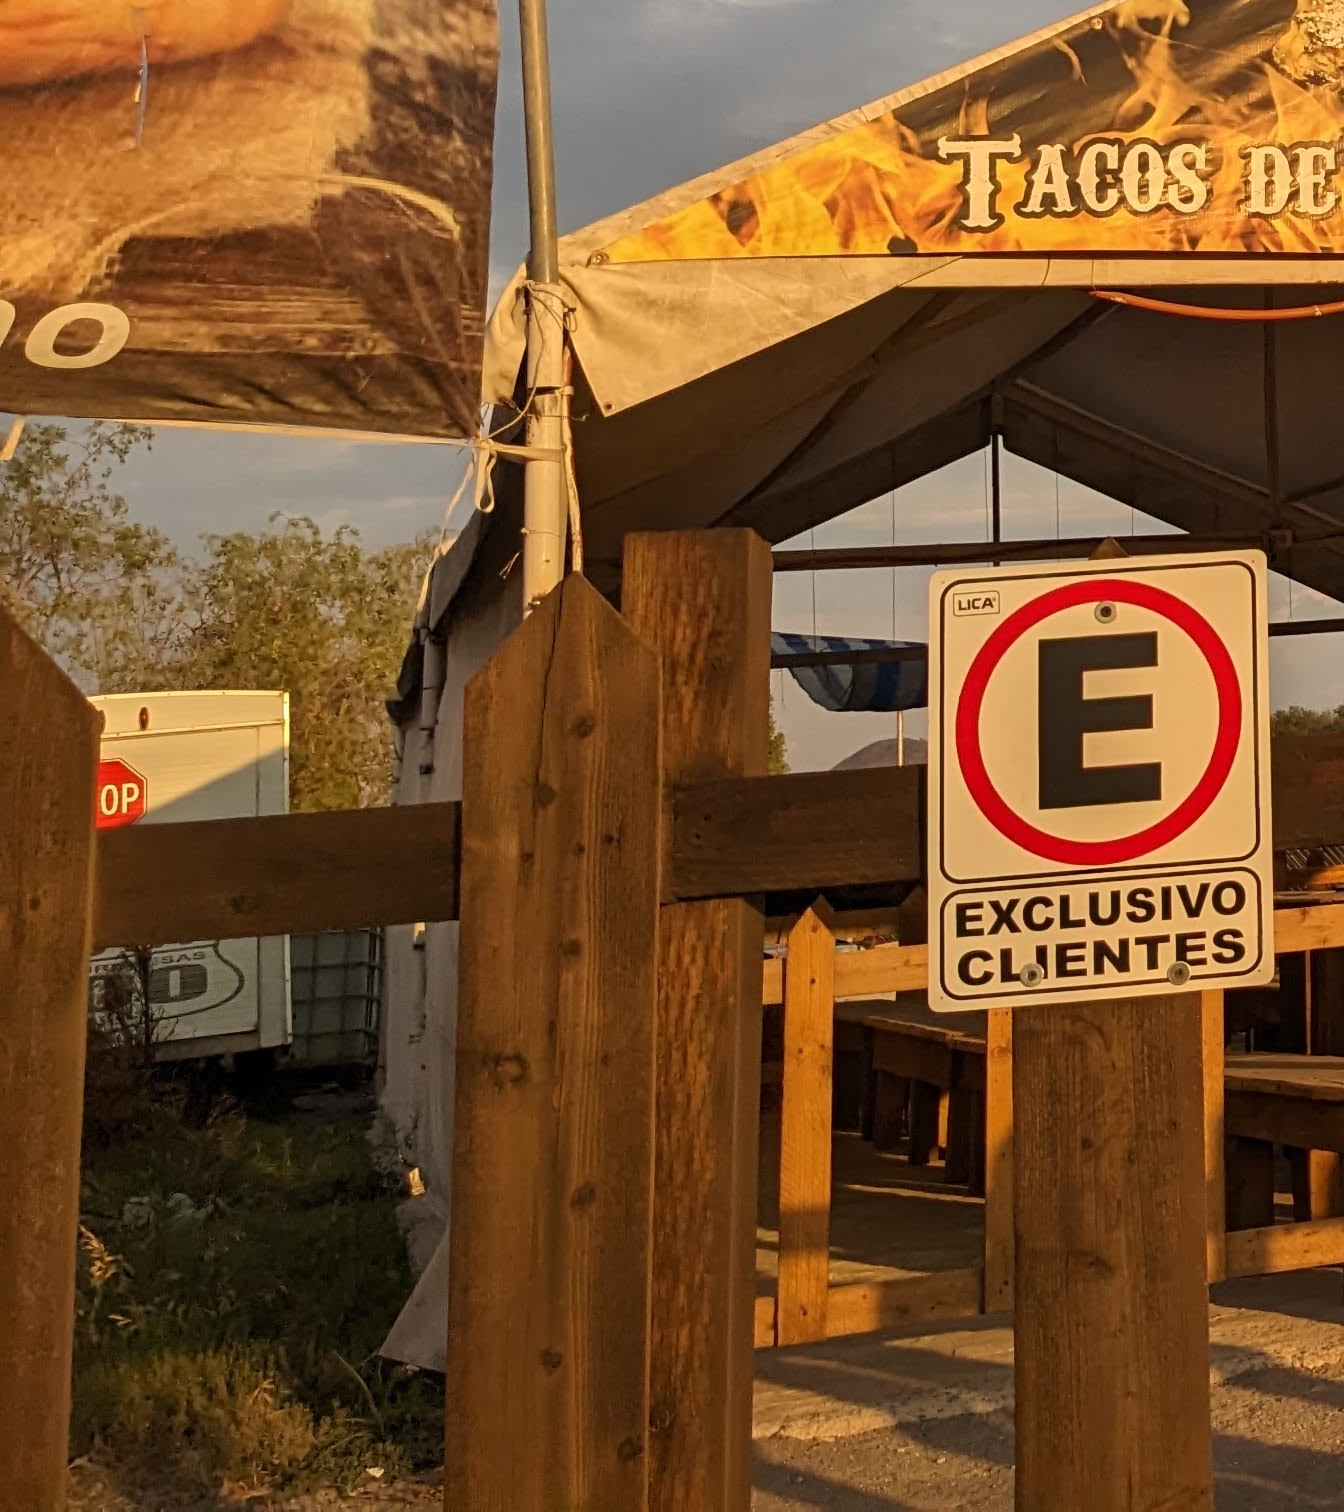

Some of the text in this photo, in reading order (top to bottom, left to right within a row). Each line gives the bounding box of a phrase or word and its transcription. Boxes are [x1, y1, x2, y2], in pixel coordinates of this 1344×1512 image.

[938, 133, 1209, 232] TACOS
[1240, 139, 1342, 220] DE
[958, 597, 994, 611] LICA
[1038, 631, 1162, 810] E
[955, 880, 1247, 938] EXCLUSIVO
[957, 928, 1247, 986] CLIENTES
